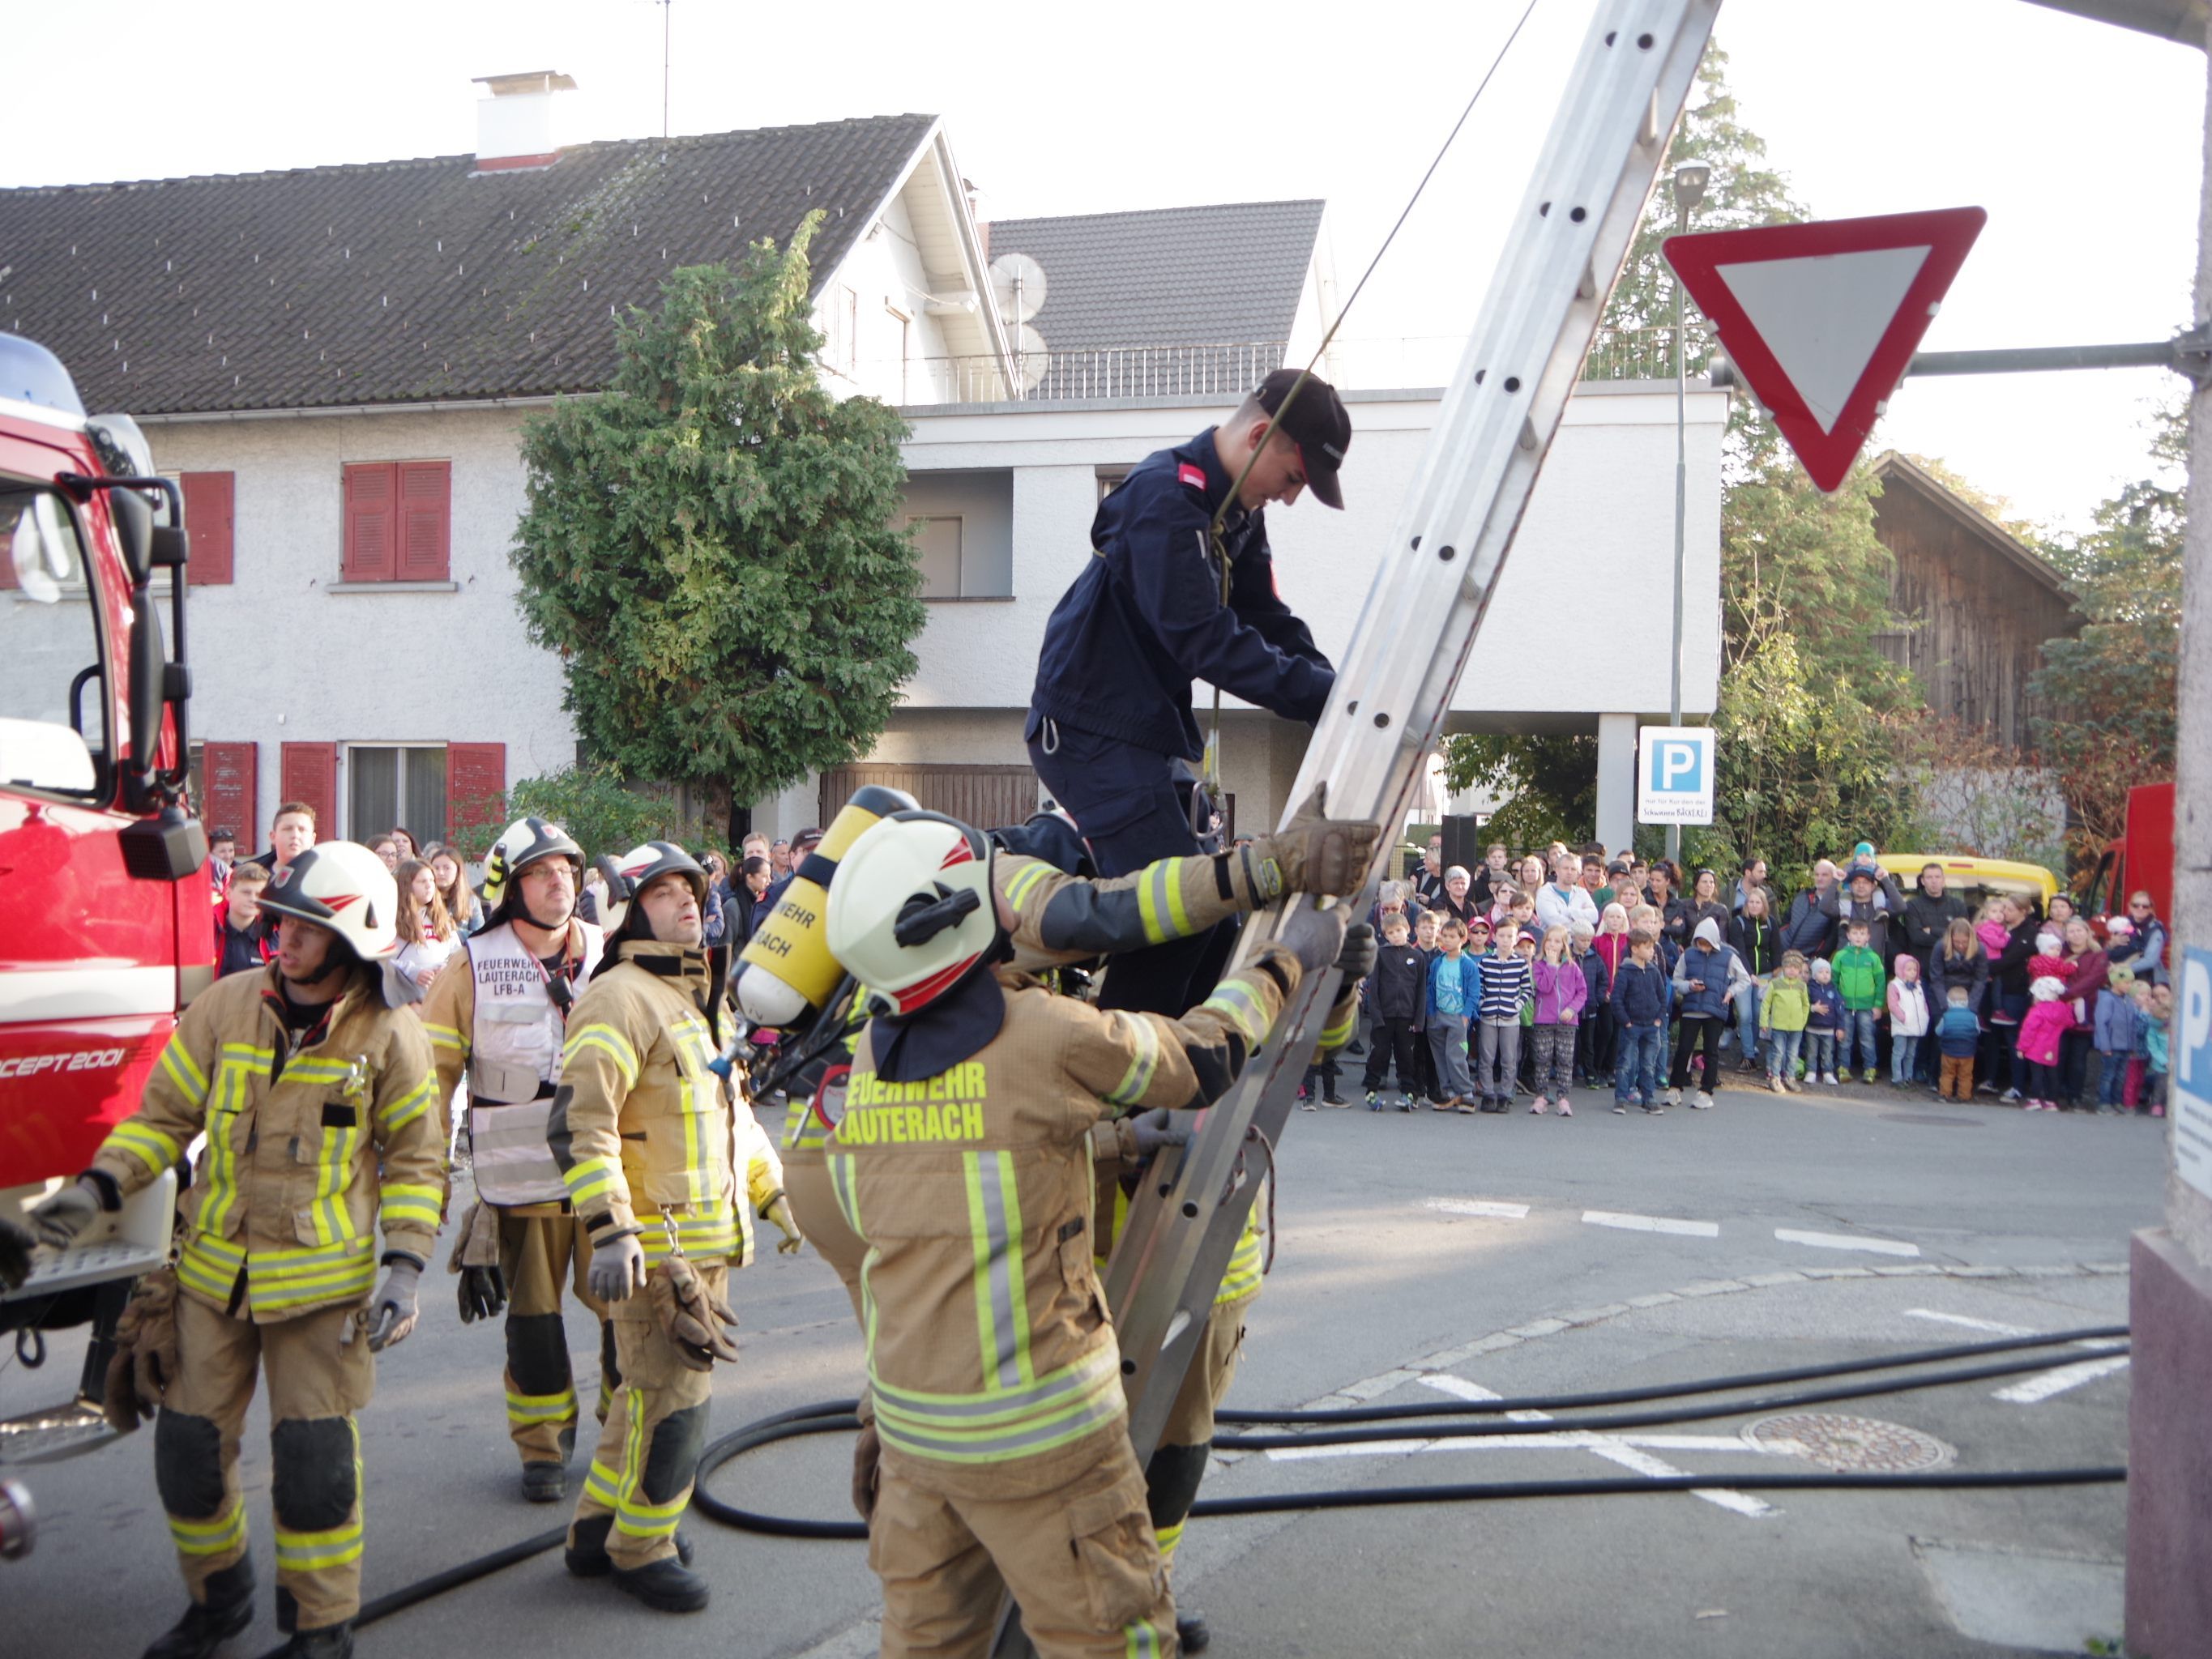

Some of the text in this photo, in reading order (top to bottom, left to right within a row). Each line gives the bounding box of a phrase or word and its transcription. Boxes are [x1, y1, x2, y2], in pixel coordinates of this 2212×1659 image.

[1663, 744, 1695, 790] P
[776, 902, 816, 929] WEHR
[756, 929, 792, 958] RACH
[479, 970, 540, 983] LAUTERACH
[493, 983, 525, 996] LFB-A
[0, 1053, 71, 1078] CEPT
[845, 1061, 987, 1107] EUERWEHR
